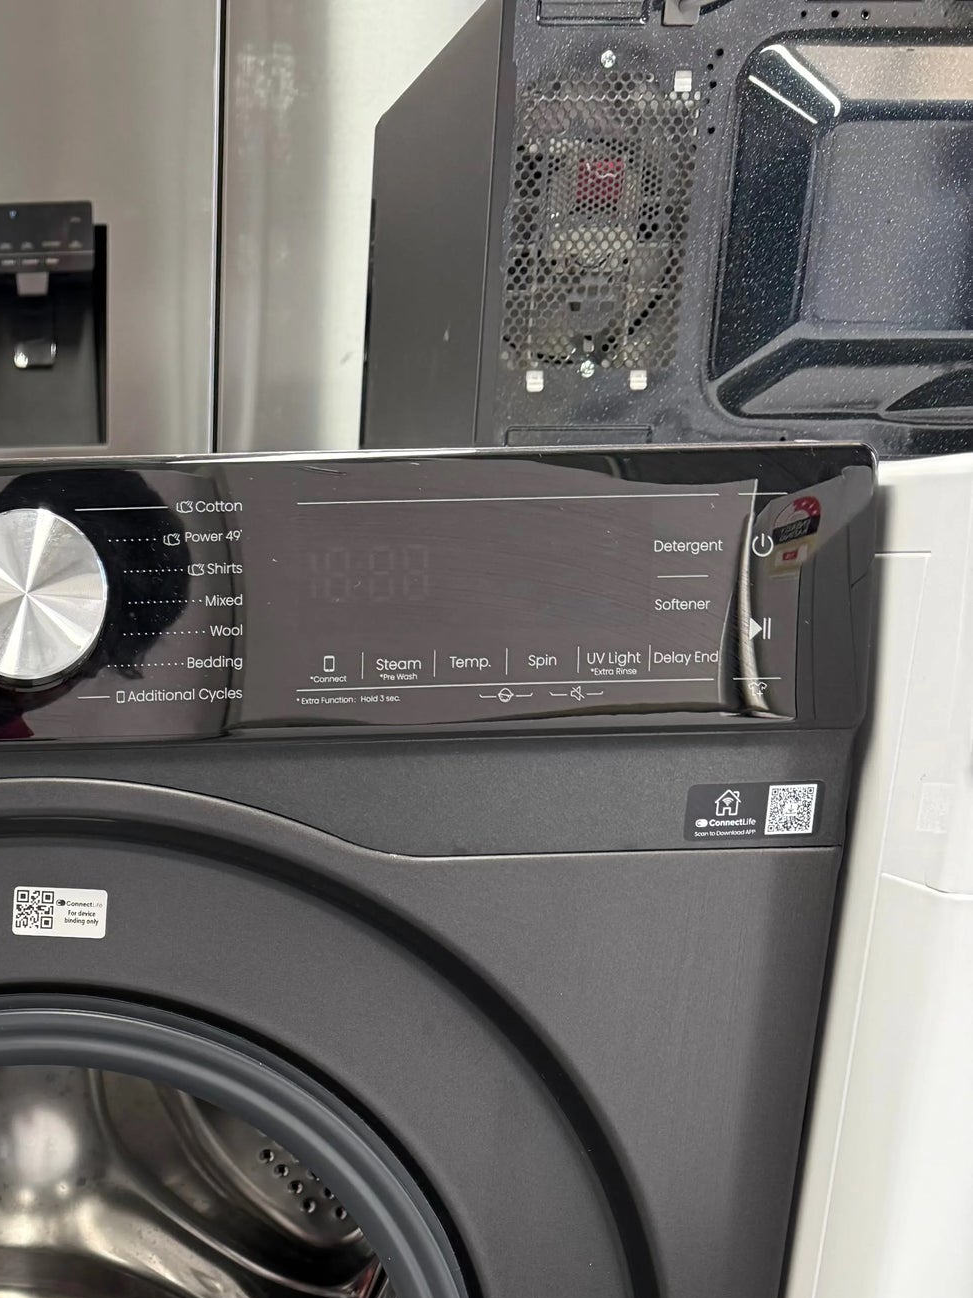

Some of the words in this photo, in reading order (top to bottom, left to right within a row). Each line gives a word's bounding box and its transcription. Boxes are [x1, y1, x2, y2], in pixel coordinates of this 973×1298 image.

[195, 501, 243, 512] Cotton
[185, 531, 223, 543] Power
[654, 540, 723, 554] Detergent
[207, 562, 243, 575] Shirts
[205, 594, 243, 606] Mixed
[654, 598, 710, 610] Softener
[210, 624, 243, 637] Wool
[187, 655, 243, 670] Bedding
[376, 658, 422, 671] Steam
[449, 656, 491, 670] Temp.
[528, 654, 557, 669] Spin
[587, 652, 606, 665] UV
[608, 651, 641, 666] Light
[654, 651, 691, 666] Delay
[694, 650, 719, 663] End
[616, 667, 637, 675] Rinse
[128, 688, 195, 702] Additional
[198, 687, 243, 702] Cycles
[301, 697, 320, 705] Extra
[360, 695, 378, 703] Hold
[709, 818, 756, 827] ConnectLife
[64, 917, 85, 925] binding
[86, 918, 99, 926] only
